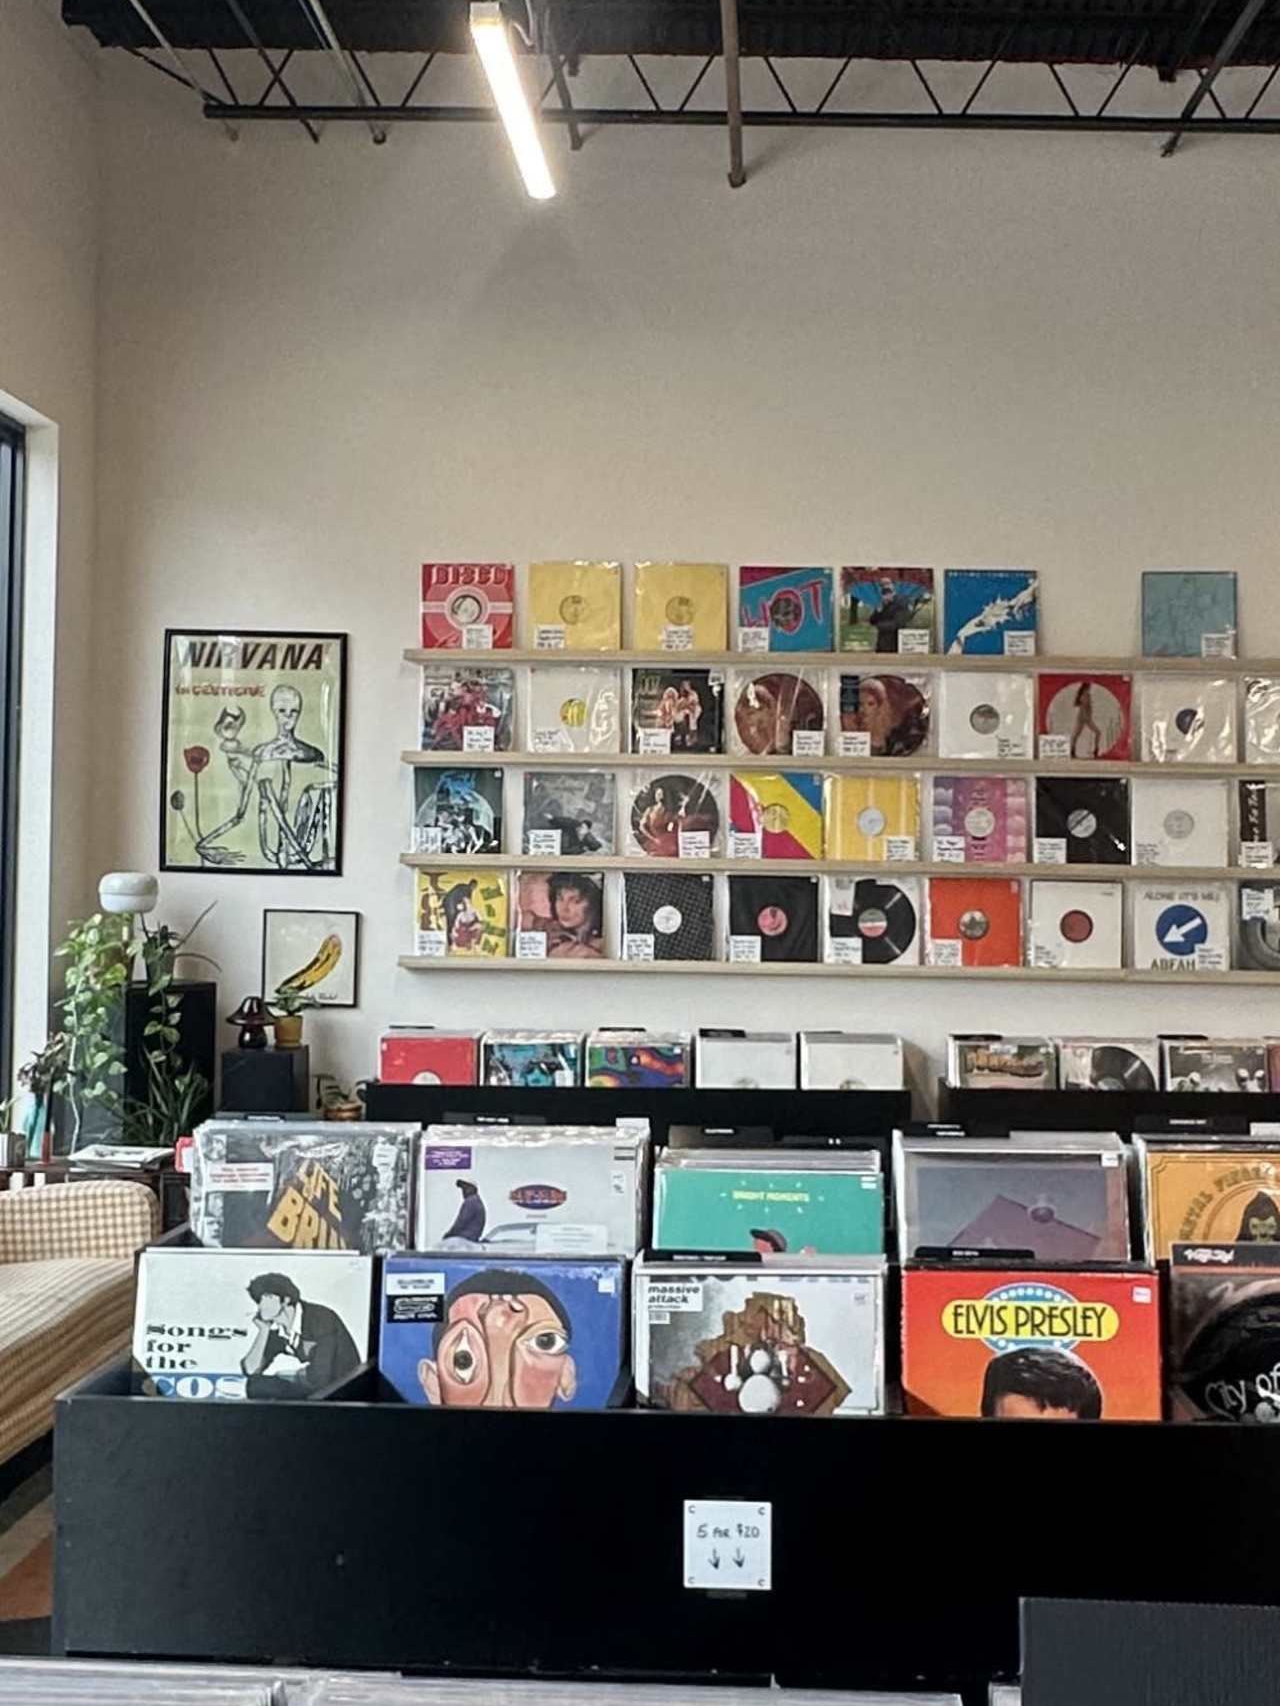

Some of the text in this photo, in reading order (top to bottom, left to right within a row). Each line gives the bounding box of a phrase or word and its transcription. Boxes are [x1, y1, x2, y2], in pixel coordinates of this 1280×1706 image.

[179, 642, 325, 671] NIRVANA
[648, 1284, 700, 1294] massive
[648, 1294, 689, 1304] attack
[952, 1304, 1107, 1339] ELVIS PRESLEY
[145, 1324, 248, 1339] Songs
[146, 1340, 192, 1353] for
[145, 1356, 198, 1370] the
[697, 1523, 708, 1539] 5
